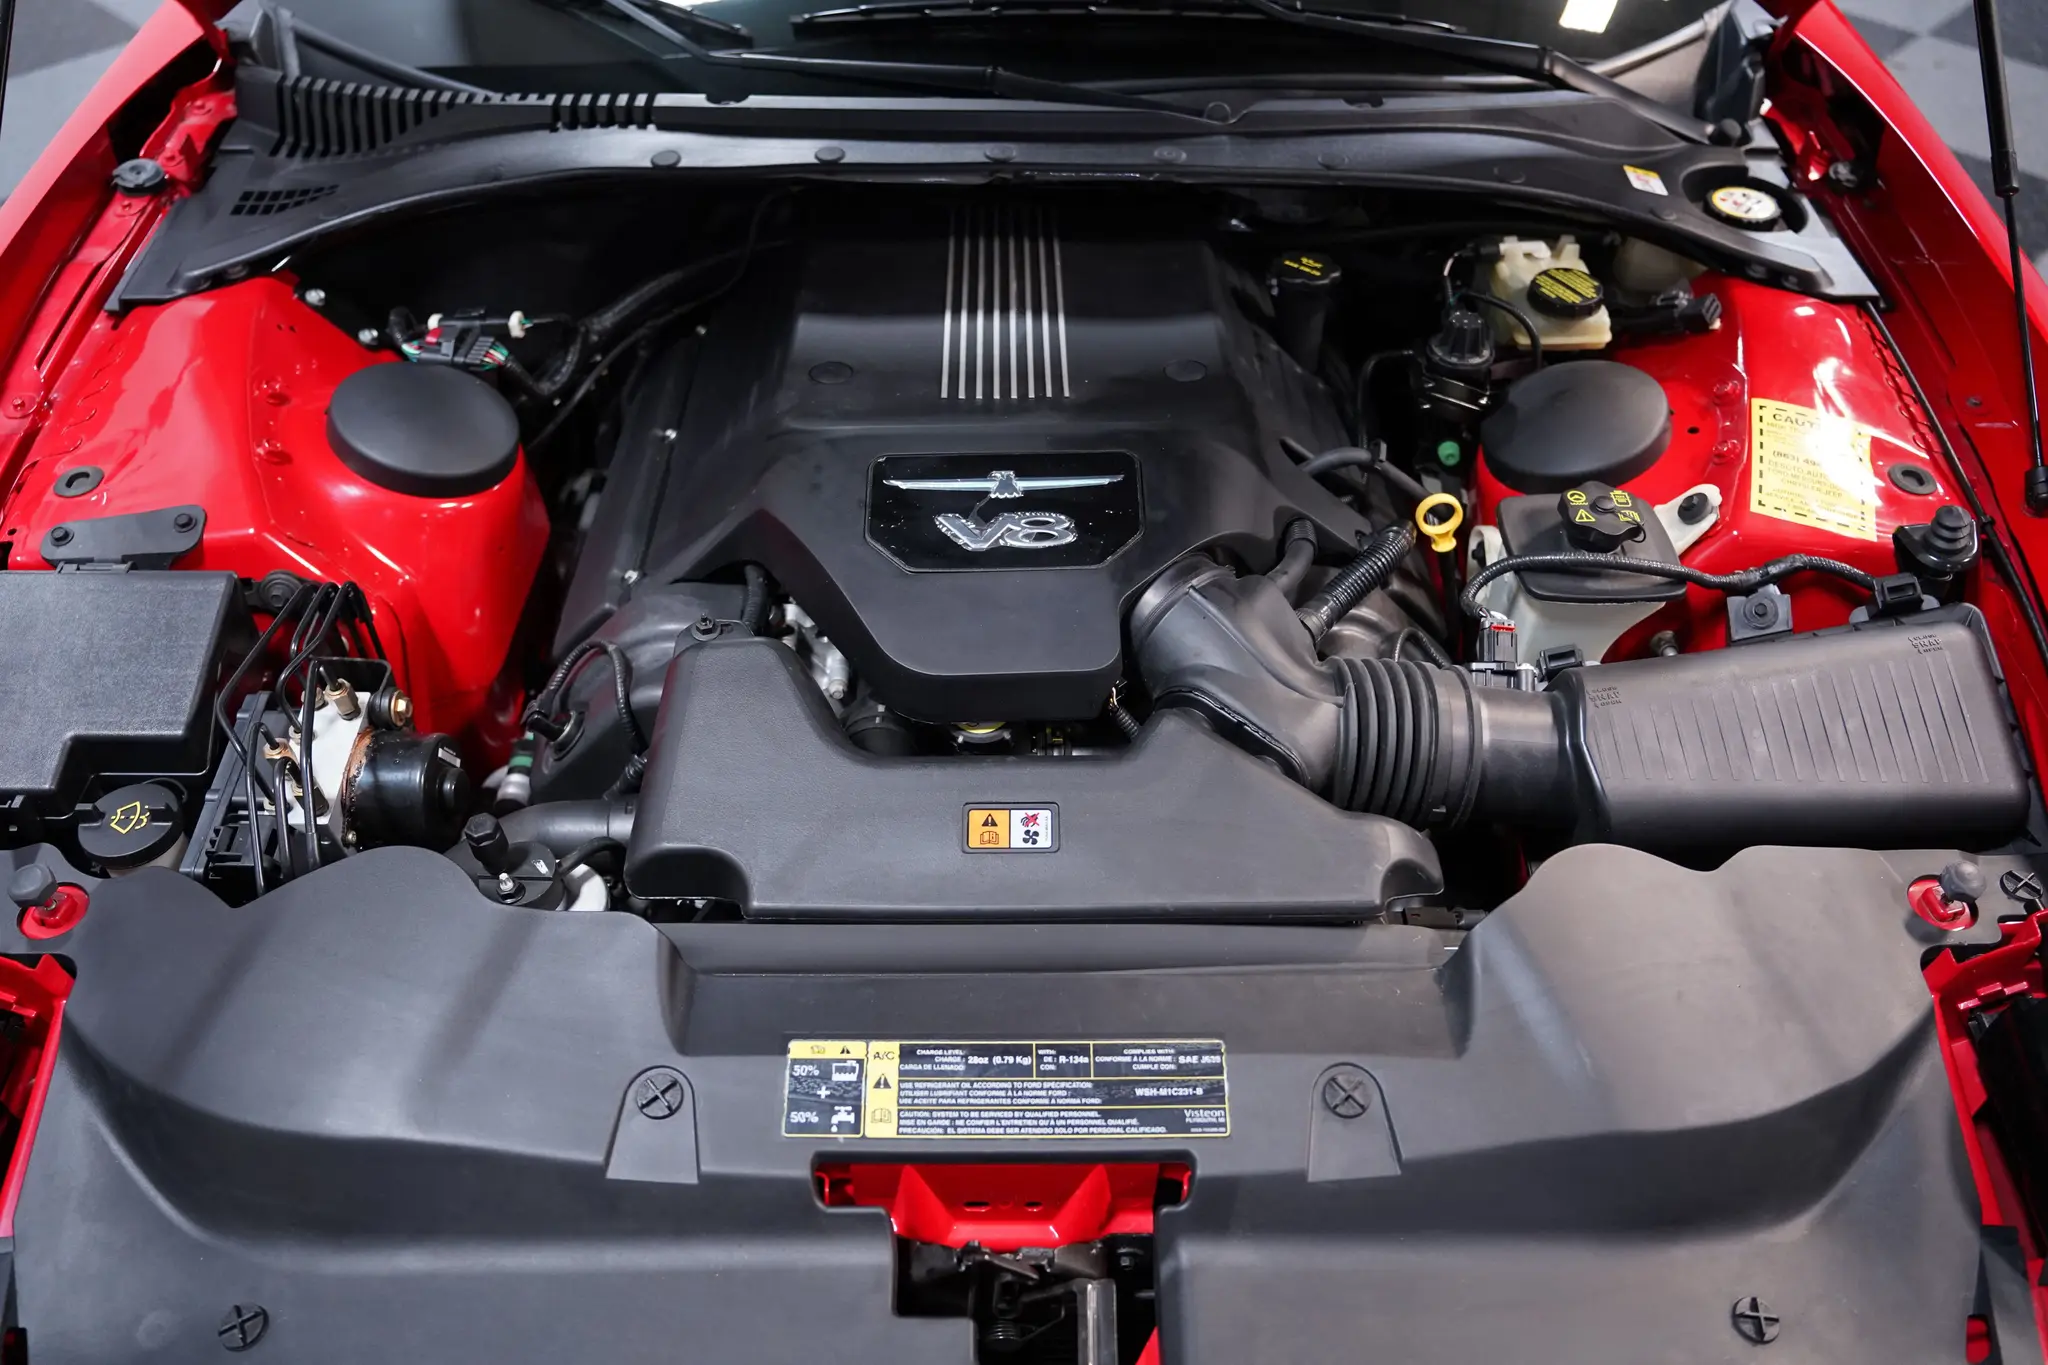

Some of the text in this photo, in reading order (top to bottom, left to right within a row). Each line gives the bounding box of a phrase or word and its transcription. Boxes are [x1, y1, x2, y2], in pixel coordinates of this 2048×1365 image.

[934, 512, 1078, 551] V8
[873, 1051, 895, 1060] A/C
[1058, 1055, 1089, 1064] R-134a
[1178, 1055, 1198, 1064] SAE
[967, 1056, 989, 1064] 28oz
[1016, 1056, 1032, 1066] Kg)
[792, 1065, 820, 1076] 50%
[790, 1111, 819, 1123] 50%
[1184, 1109, 1224, 1117] Visteon
